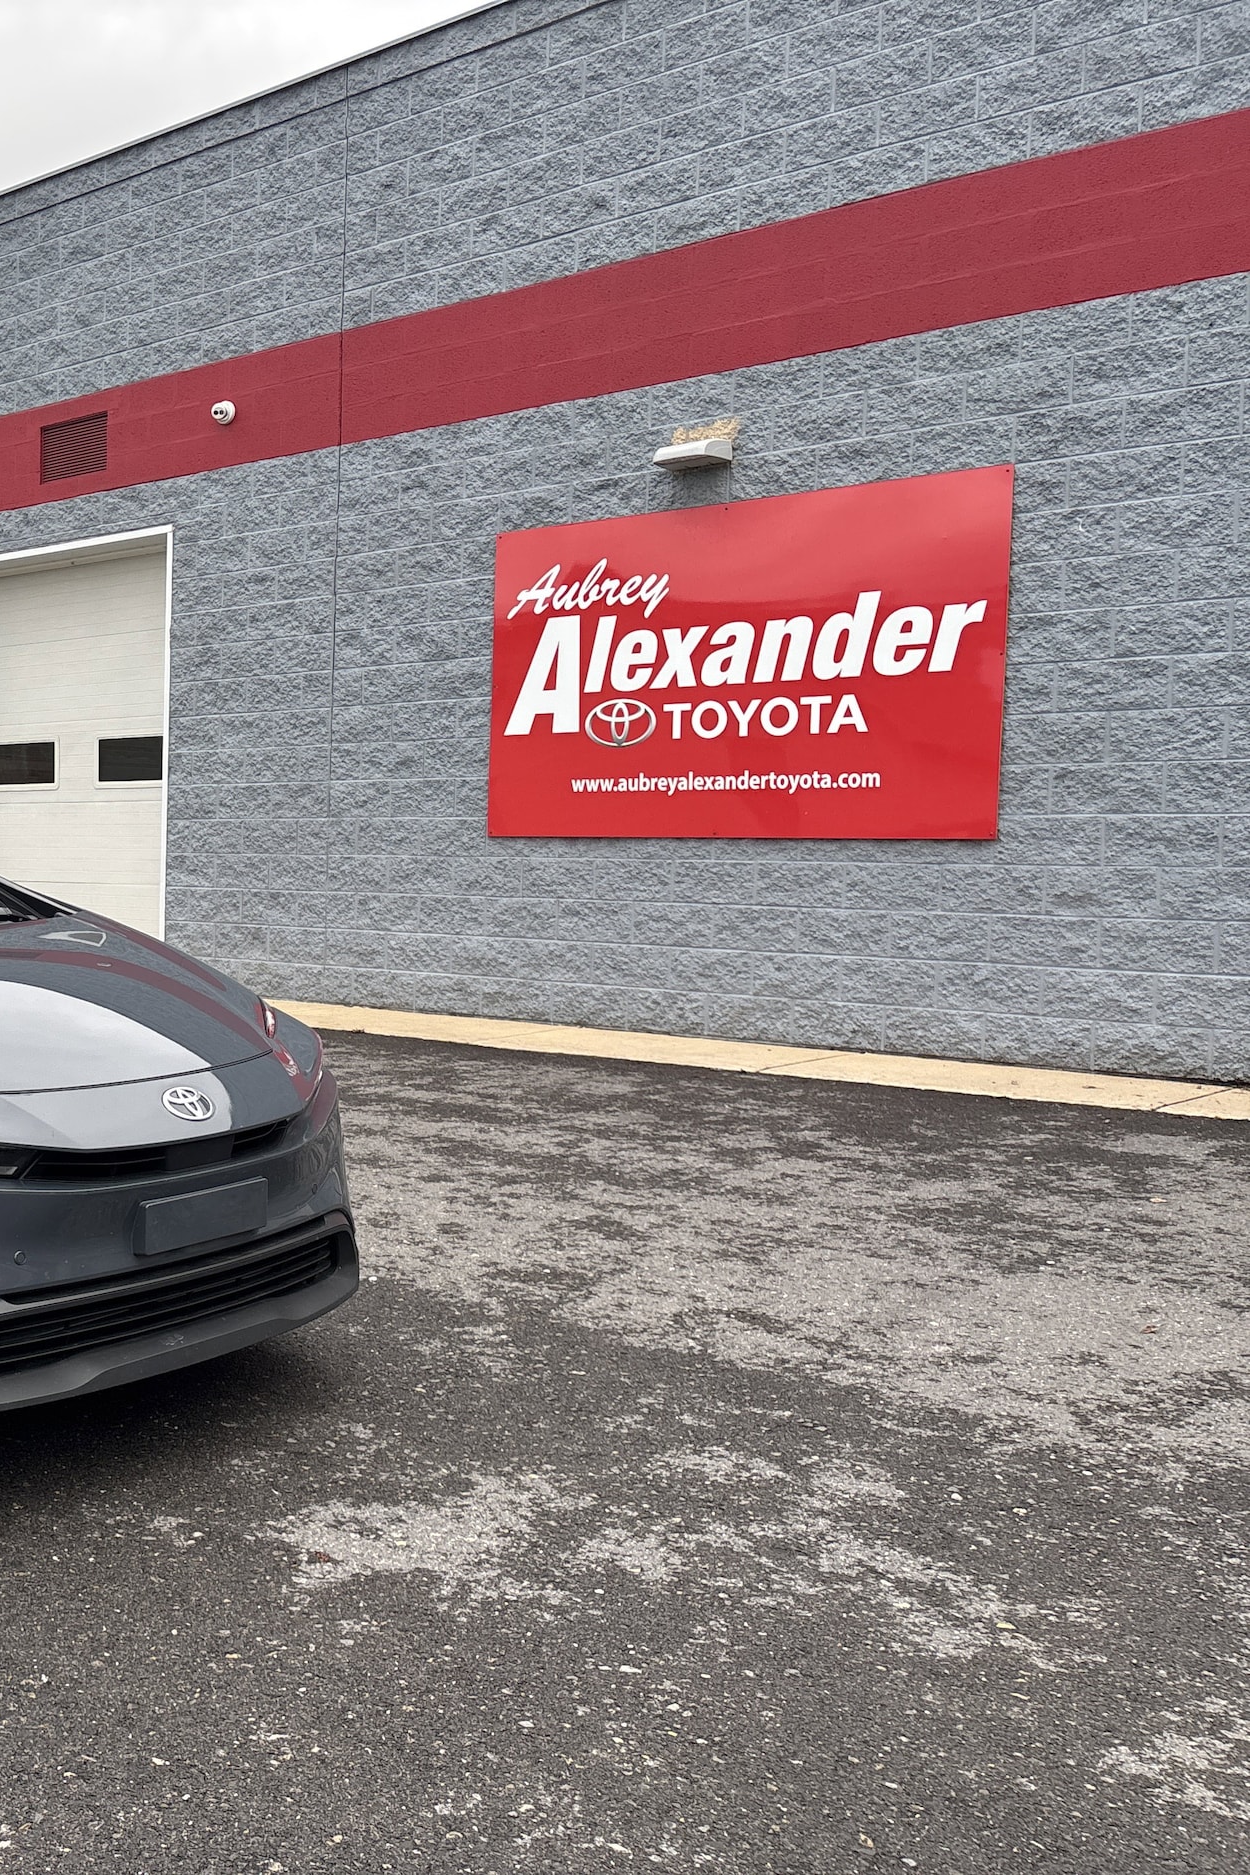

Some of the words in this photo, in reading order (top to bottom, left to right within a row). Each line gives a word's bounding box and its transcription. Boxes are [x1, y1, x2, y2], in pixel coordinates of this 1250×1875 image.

[507, 558, 670, 619] Aubrey
[504, 591, 987, 736] Alexander
[662, 695, 869, 740] TOYOTA
[571, 770, 881, 796] www.aubreyalexandertoyota.com
